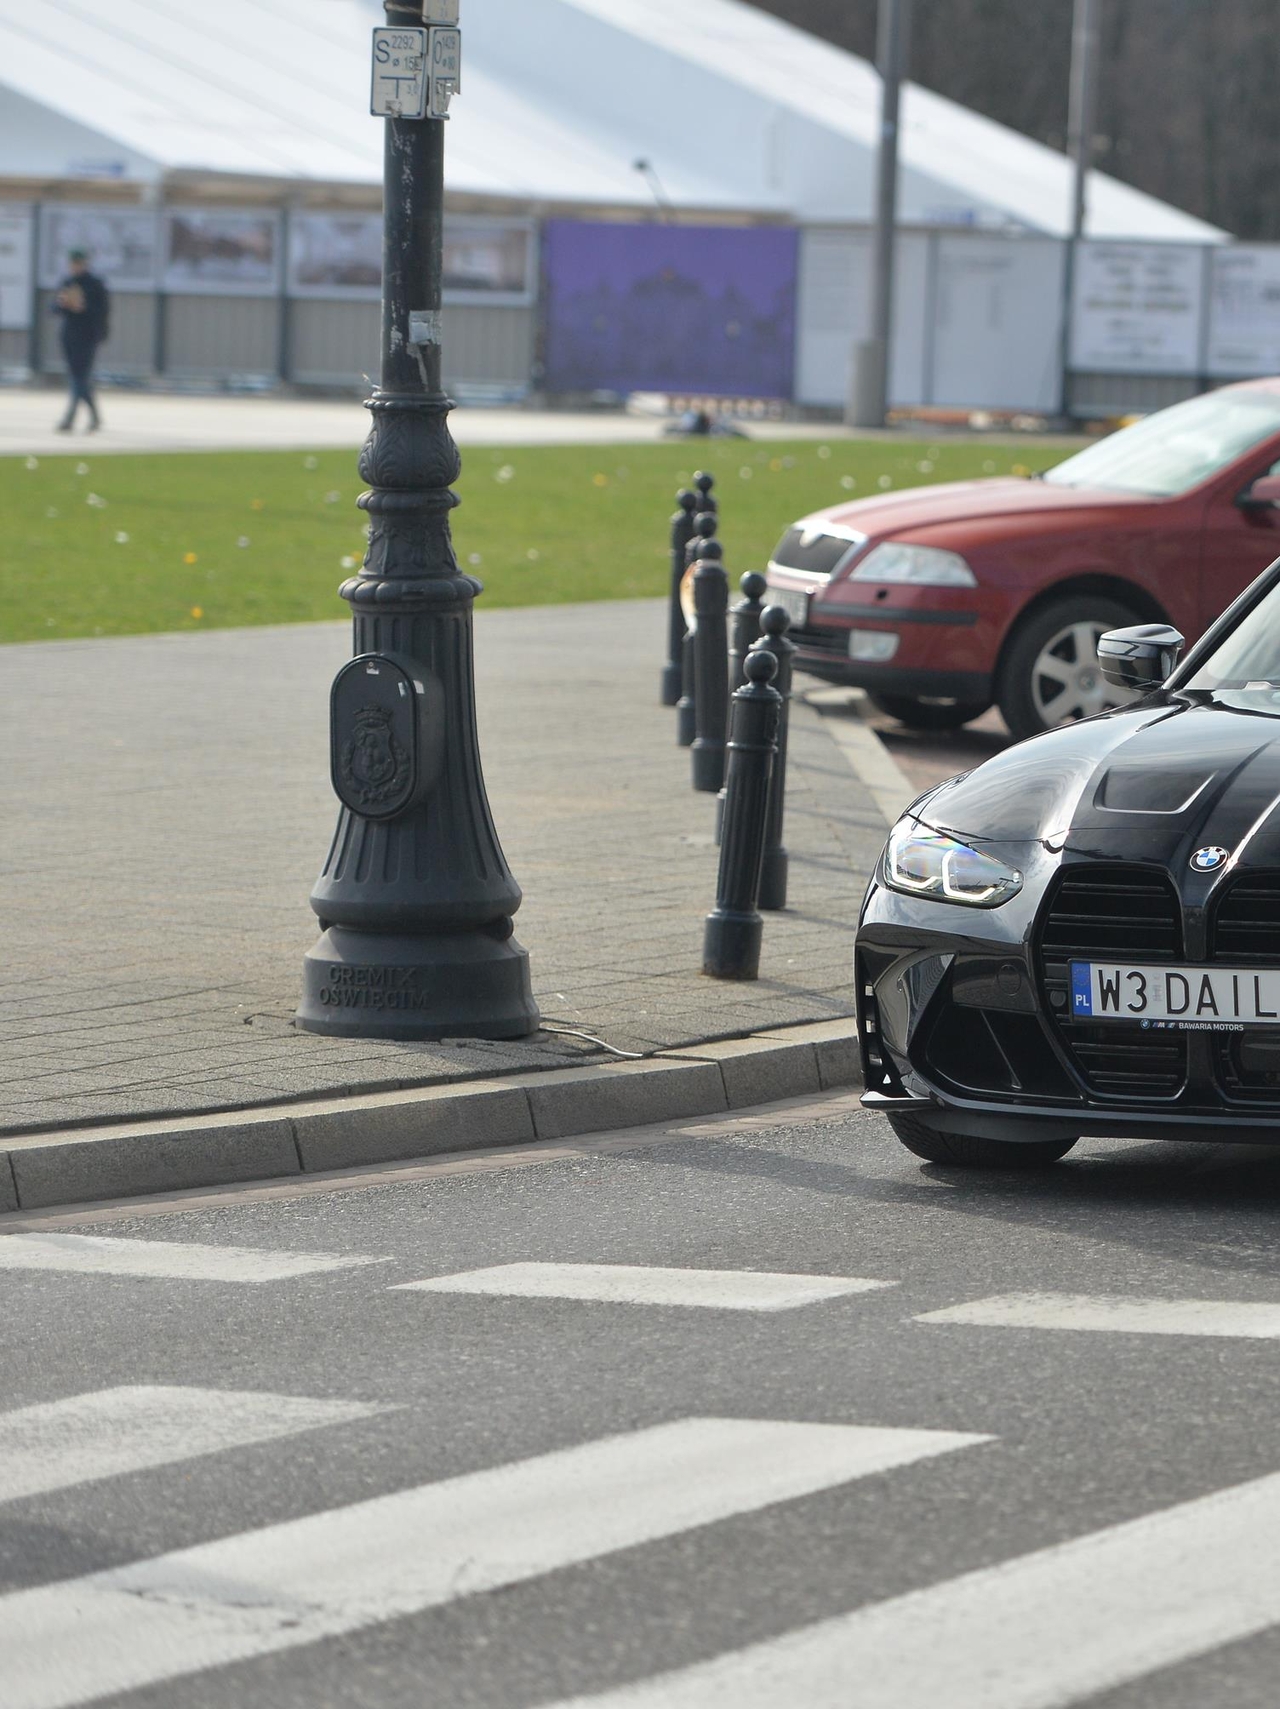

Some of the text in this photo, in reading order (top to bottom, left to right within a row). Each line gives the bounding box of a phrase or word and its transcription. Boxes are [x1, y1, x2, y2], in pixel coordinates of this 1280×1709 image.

[375, 40, 390, 63] S
[1075, 994, 1089, 1007] PL
[1098, 970, 1148, 1013] W3
[1179, 1022, 1212, 1030] BAWARIA
[1213, 1023, 1244, 1031] MOTORS
